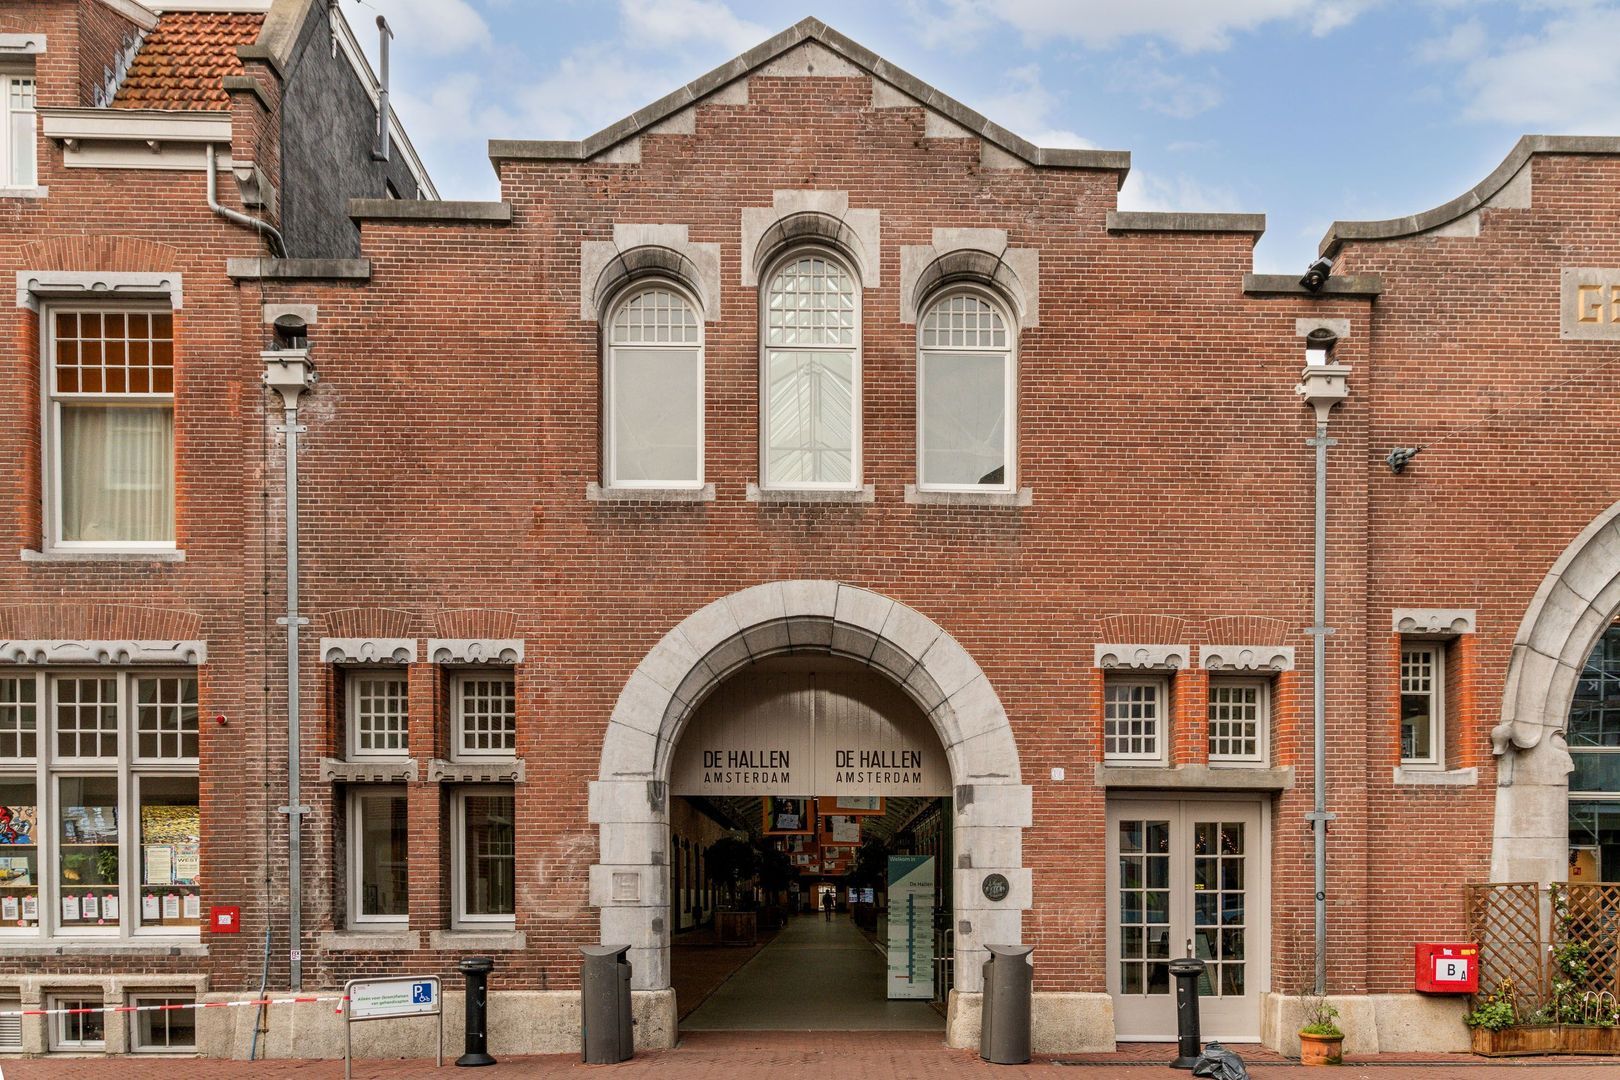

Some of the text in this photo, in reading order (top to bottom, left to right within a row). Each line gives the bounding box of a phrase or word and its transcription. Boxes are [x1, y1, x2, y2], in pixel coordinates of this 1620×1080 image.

[703, 750, 790, 769] DE HALLEN
[835, 750, 921, 769] DE HALLEN
[704, 771, 790, 784] AMSTERDAM
[836, 771, 922, 784] AMSTERDAM
[1447, 963, 1456, 976] B
[1461, 970, 1466, 981] A
[414, 985, 423, 997] P
